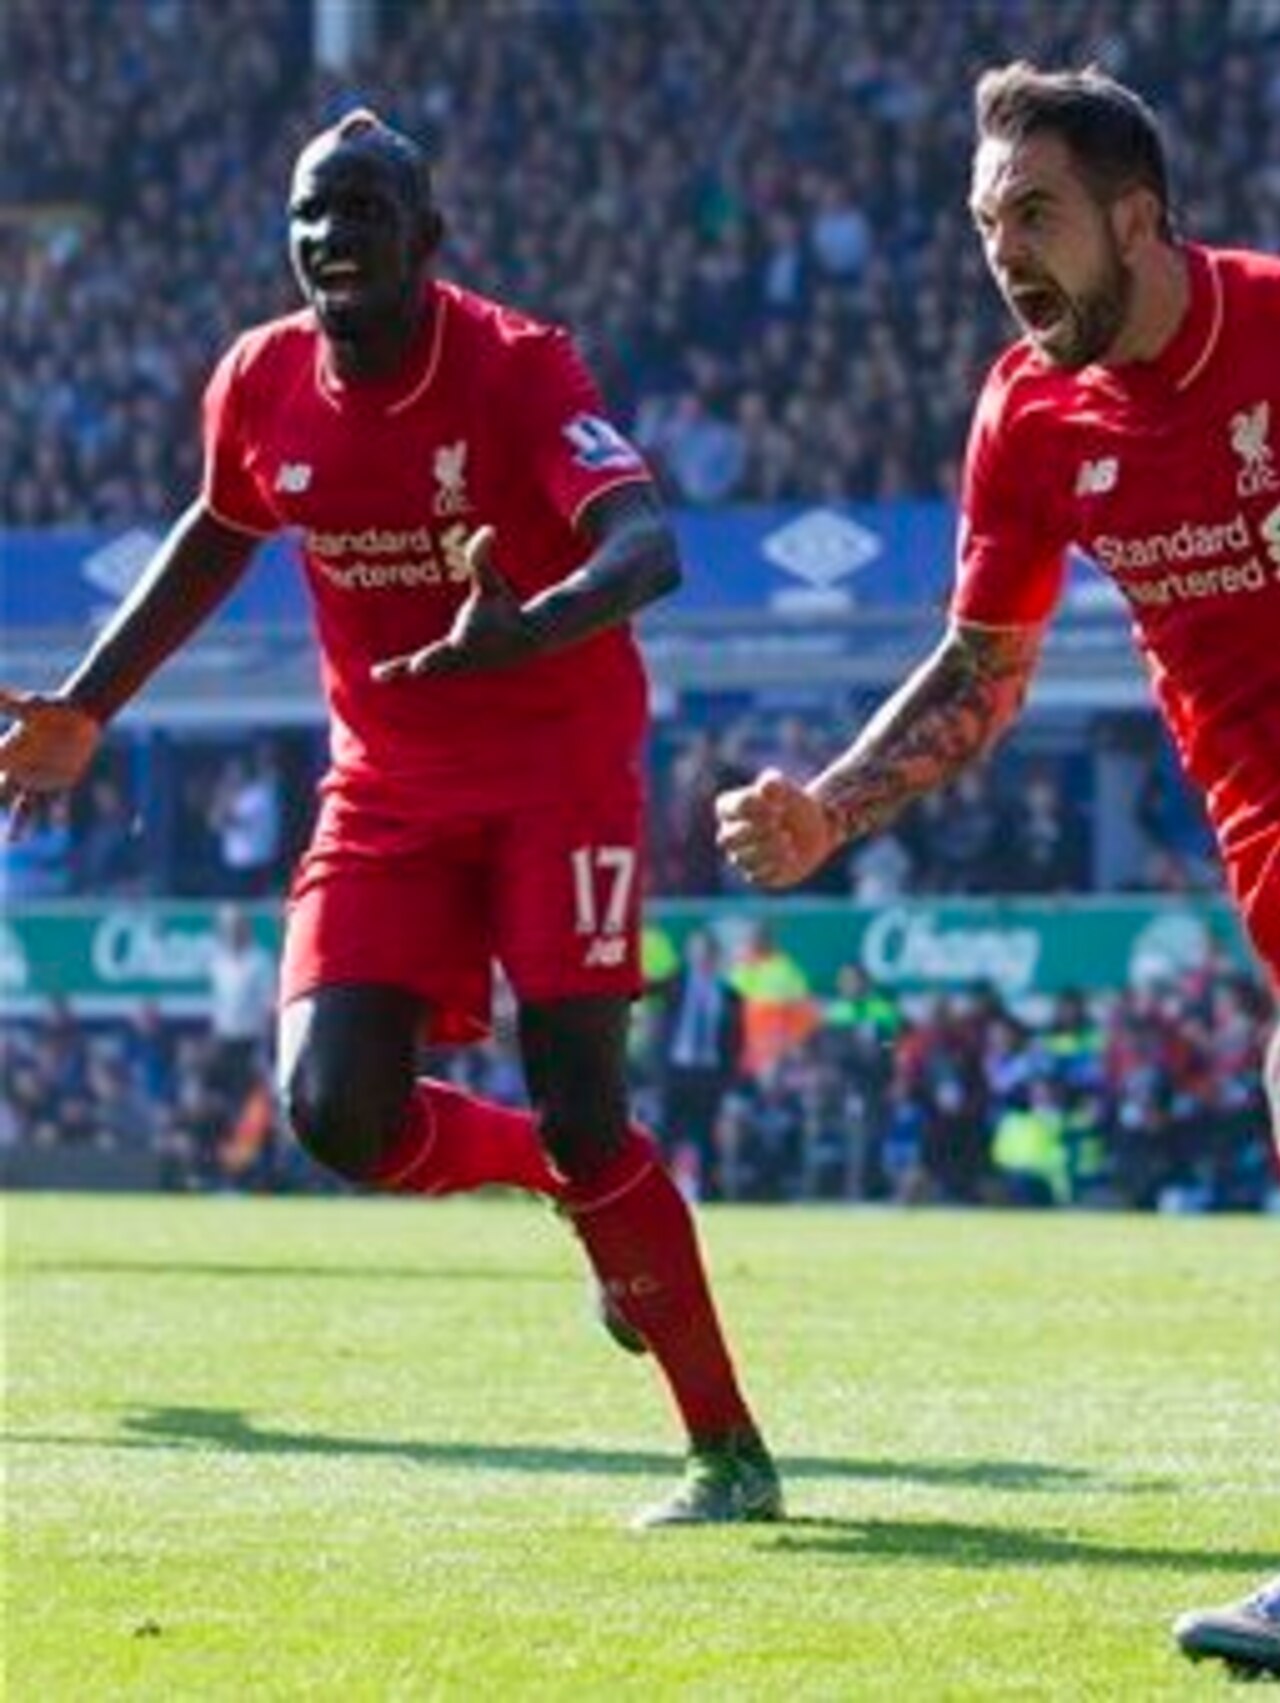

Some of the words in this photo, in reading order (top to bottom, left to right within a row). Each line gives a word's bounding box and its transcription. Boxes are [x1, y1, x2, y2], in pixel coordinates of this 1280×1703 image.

[307, 527, 432, 557] tandard
[1092, 513, 1250, 571] Standard
[572, 846, 638, 933] 17
[862, 906, 1041, 1006] Chang
